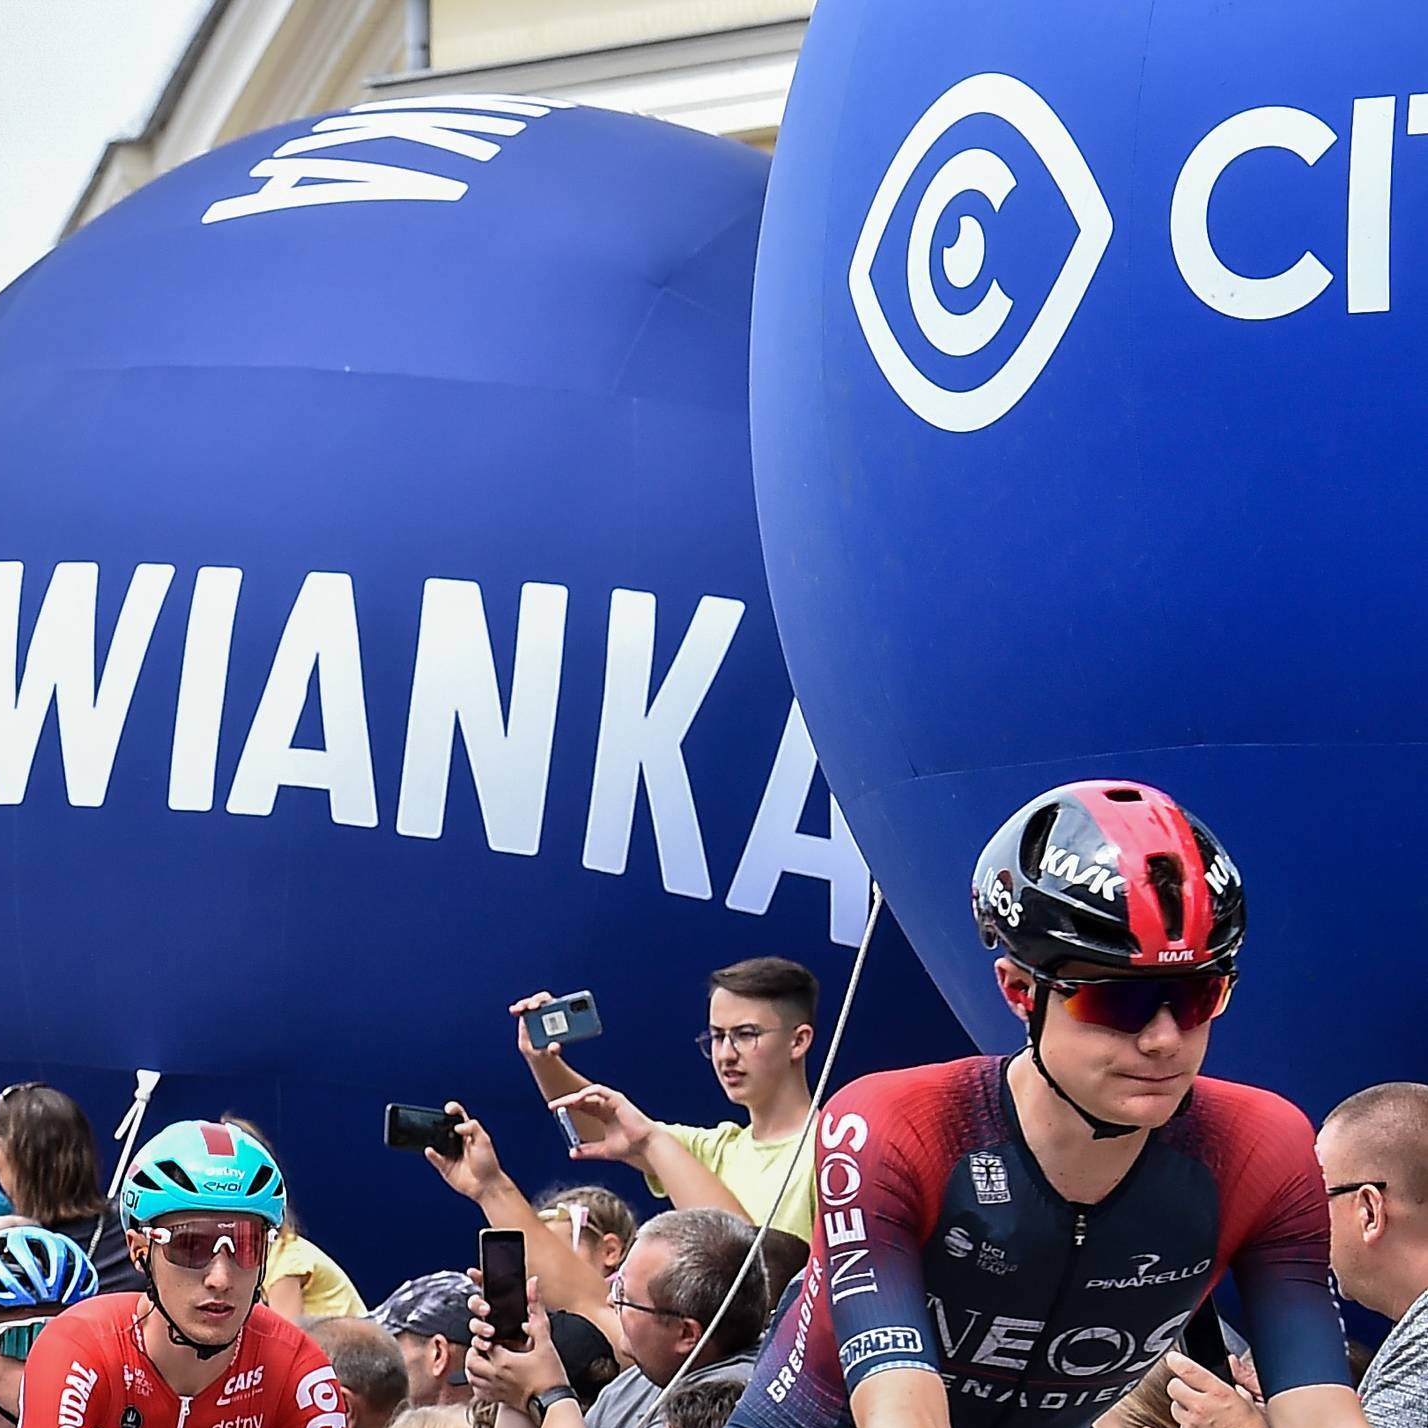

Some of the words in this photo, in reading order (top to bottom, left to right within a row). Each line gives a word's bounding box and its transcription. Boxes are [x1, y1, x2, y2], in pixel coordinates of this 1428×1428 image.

[1039, 844, 1127, 901] KASK
[1158, 949, 1195, 963] KASK
[820, 1111, 879, 1305] INEOS
[981, 1242, 1005, 1259] UCI
[1084, 1259, 1211, 1290] PINARELLO
[766, 1256, 824, 1405] GRENADIER
